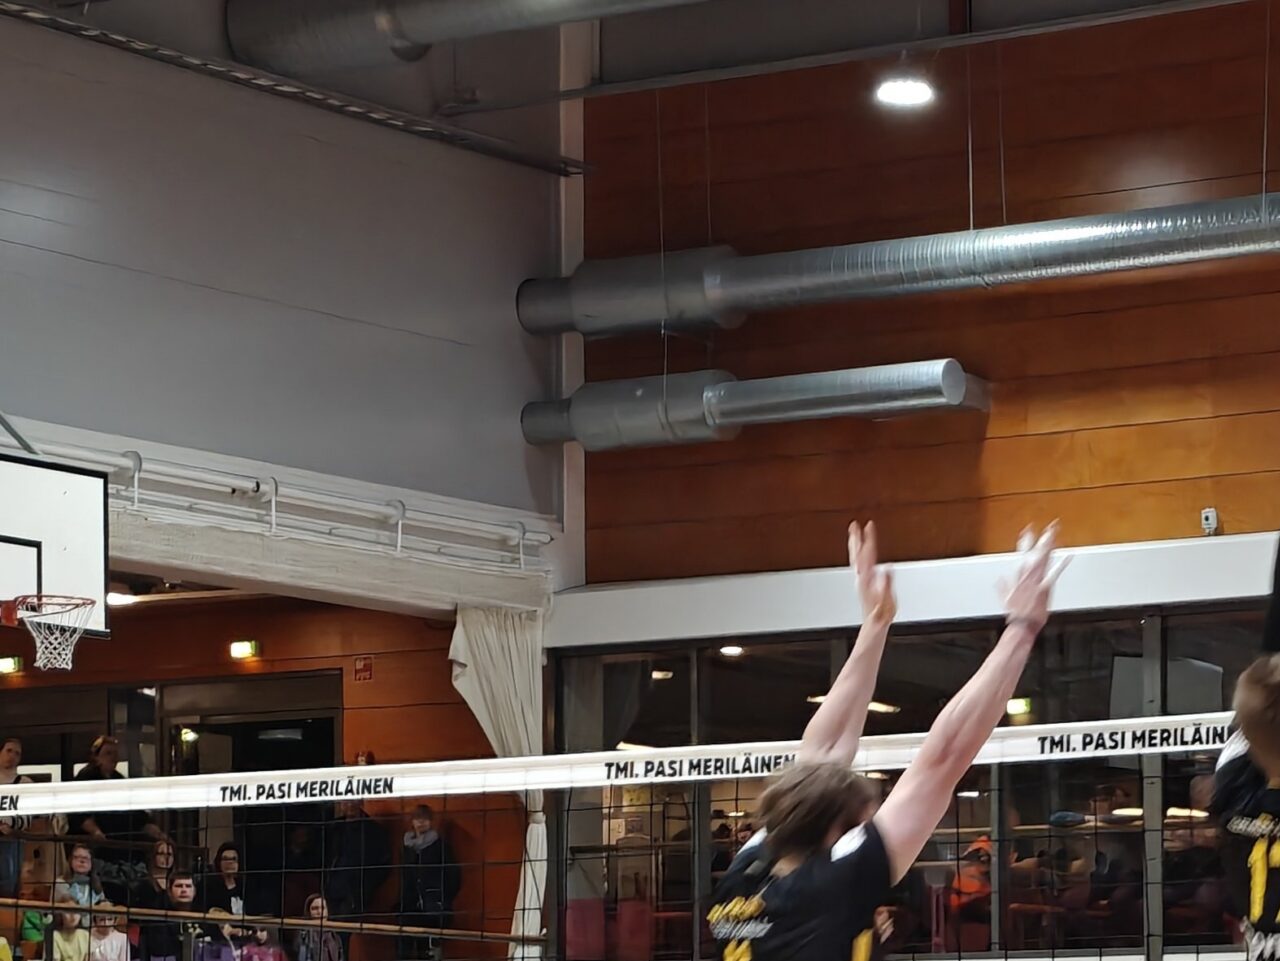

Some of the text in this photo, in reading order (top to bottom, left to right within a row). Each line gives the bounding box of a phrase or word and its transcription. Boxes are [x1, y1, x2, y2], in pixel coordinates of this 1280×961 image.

[1038, 722, 1229, 755] TMI. PASI MERILÄIN
[605, 762, 640, 780] TMI.
[644, 759, 684, 778] PASI
[219, 776, 394, 802] TMI. PASI MERILÄINEN
